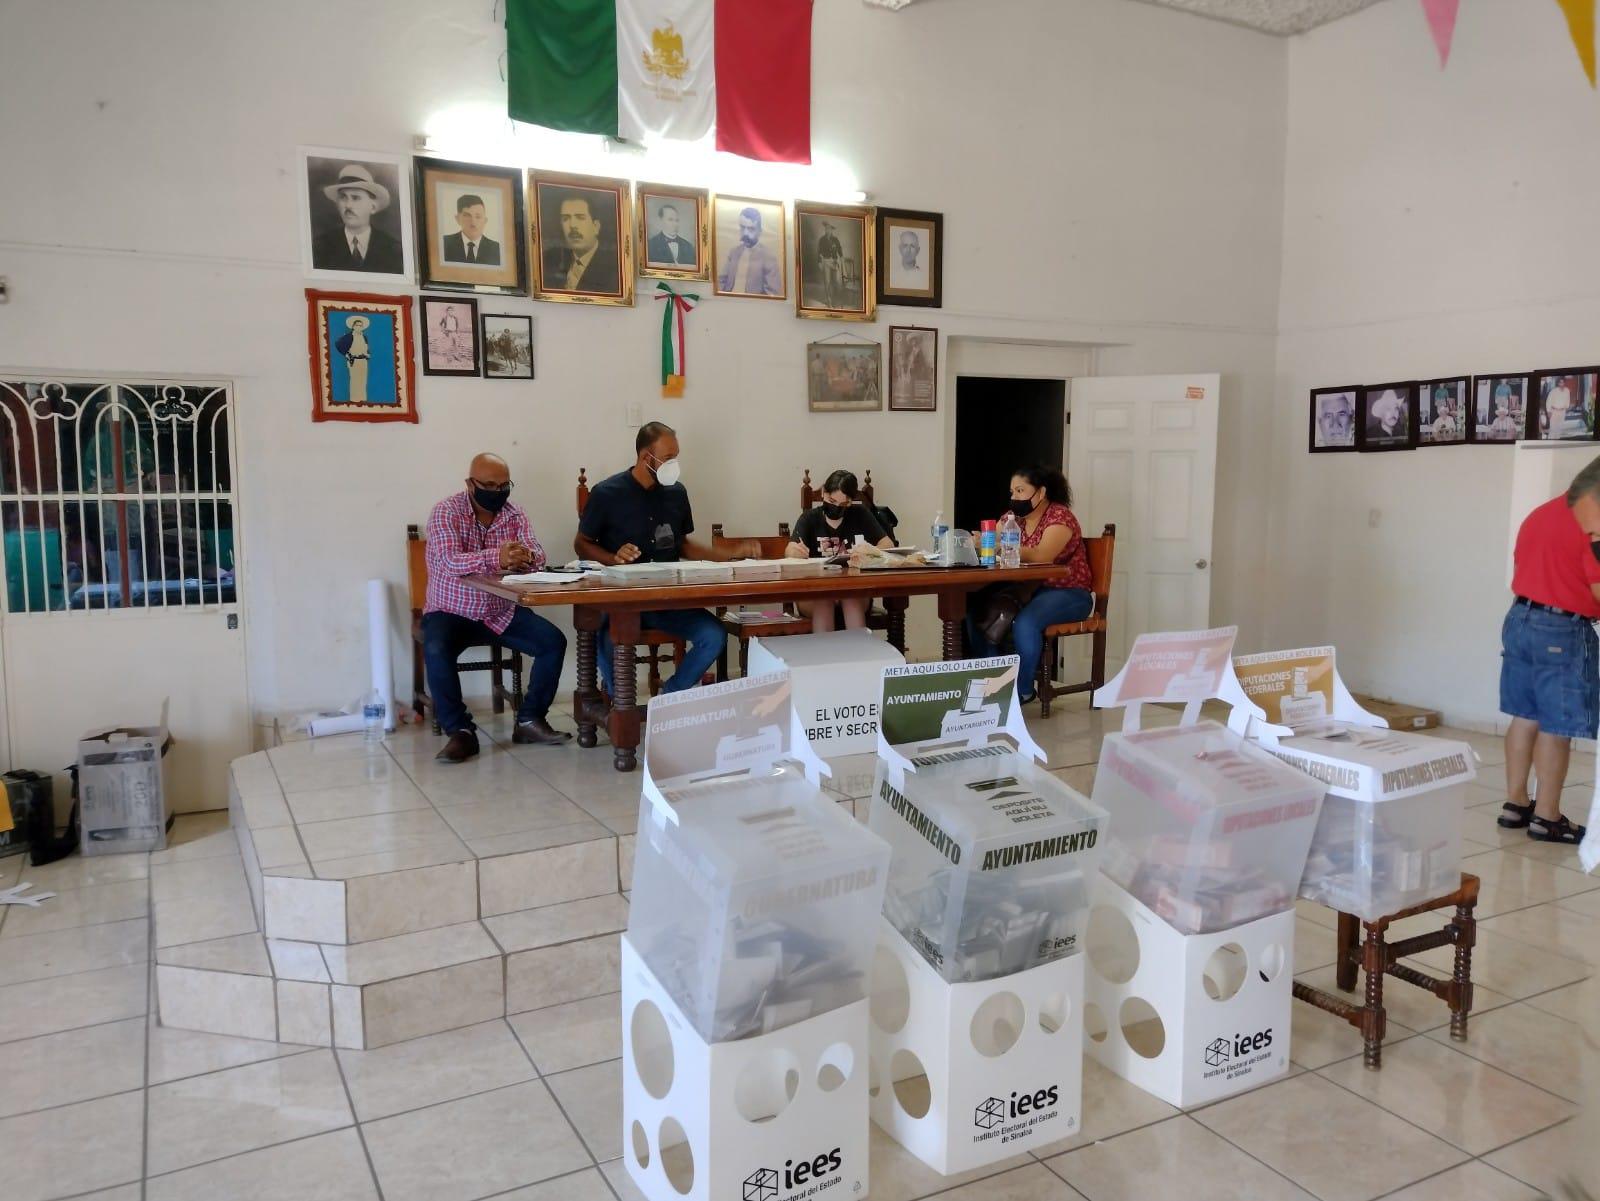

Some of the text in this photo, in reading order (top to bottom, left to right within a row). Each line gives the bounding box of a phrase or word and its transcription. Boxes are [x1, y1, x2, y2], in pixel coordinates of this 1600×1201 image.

[884, 666, 910, 676] META
[936, 663, 960, 672] SOLO
[962, 661, 973, 670] LA
[974, 658, 1006, 669] BOLETA
[1008, 656, 1019, 665] DE
[886, 690, 962, 705] AYUNTAMIENTO
[651, 708, 736, 734] GUBERNATURA
[816, 709, 830, 721] EL
[834, 705, 866, 719] VOTO
[836, 725, 843, 737] Y
[846, 722, 877, 736] SECR
[945, 718, 996, 733] AYUNTAMIENTO
[909, 745, 1012, 767] YUNTAMIENTO
[880, 779, 961, 865] AYUNTAMIENTO
[1011, 811, 1055, 823] BOLETA
[982, 828, 1098, 871] AYUNTAMIENTO
[1054, 934, 1077, 950] iees
[1234, 1028, 1272, 1058] iees
[1010, 1085, 1058, 1118] iees
[973, 1111, 1058, 1143] Instituto Electoral del Estado
[1001, 1129, 1032, 1144] de Sinaloa
[785, 1147, 842, 1189] iees
[807, 1185, 818, 1196] del
[819, 1176, 842, 1191] Estado
